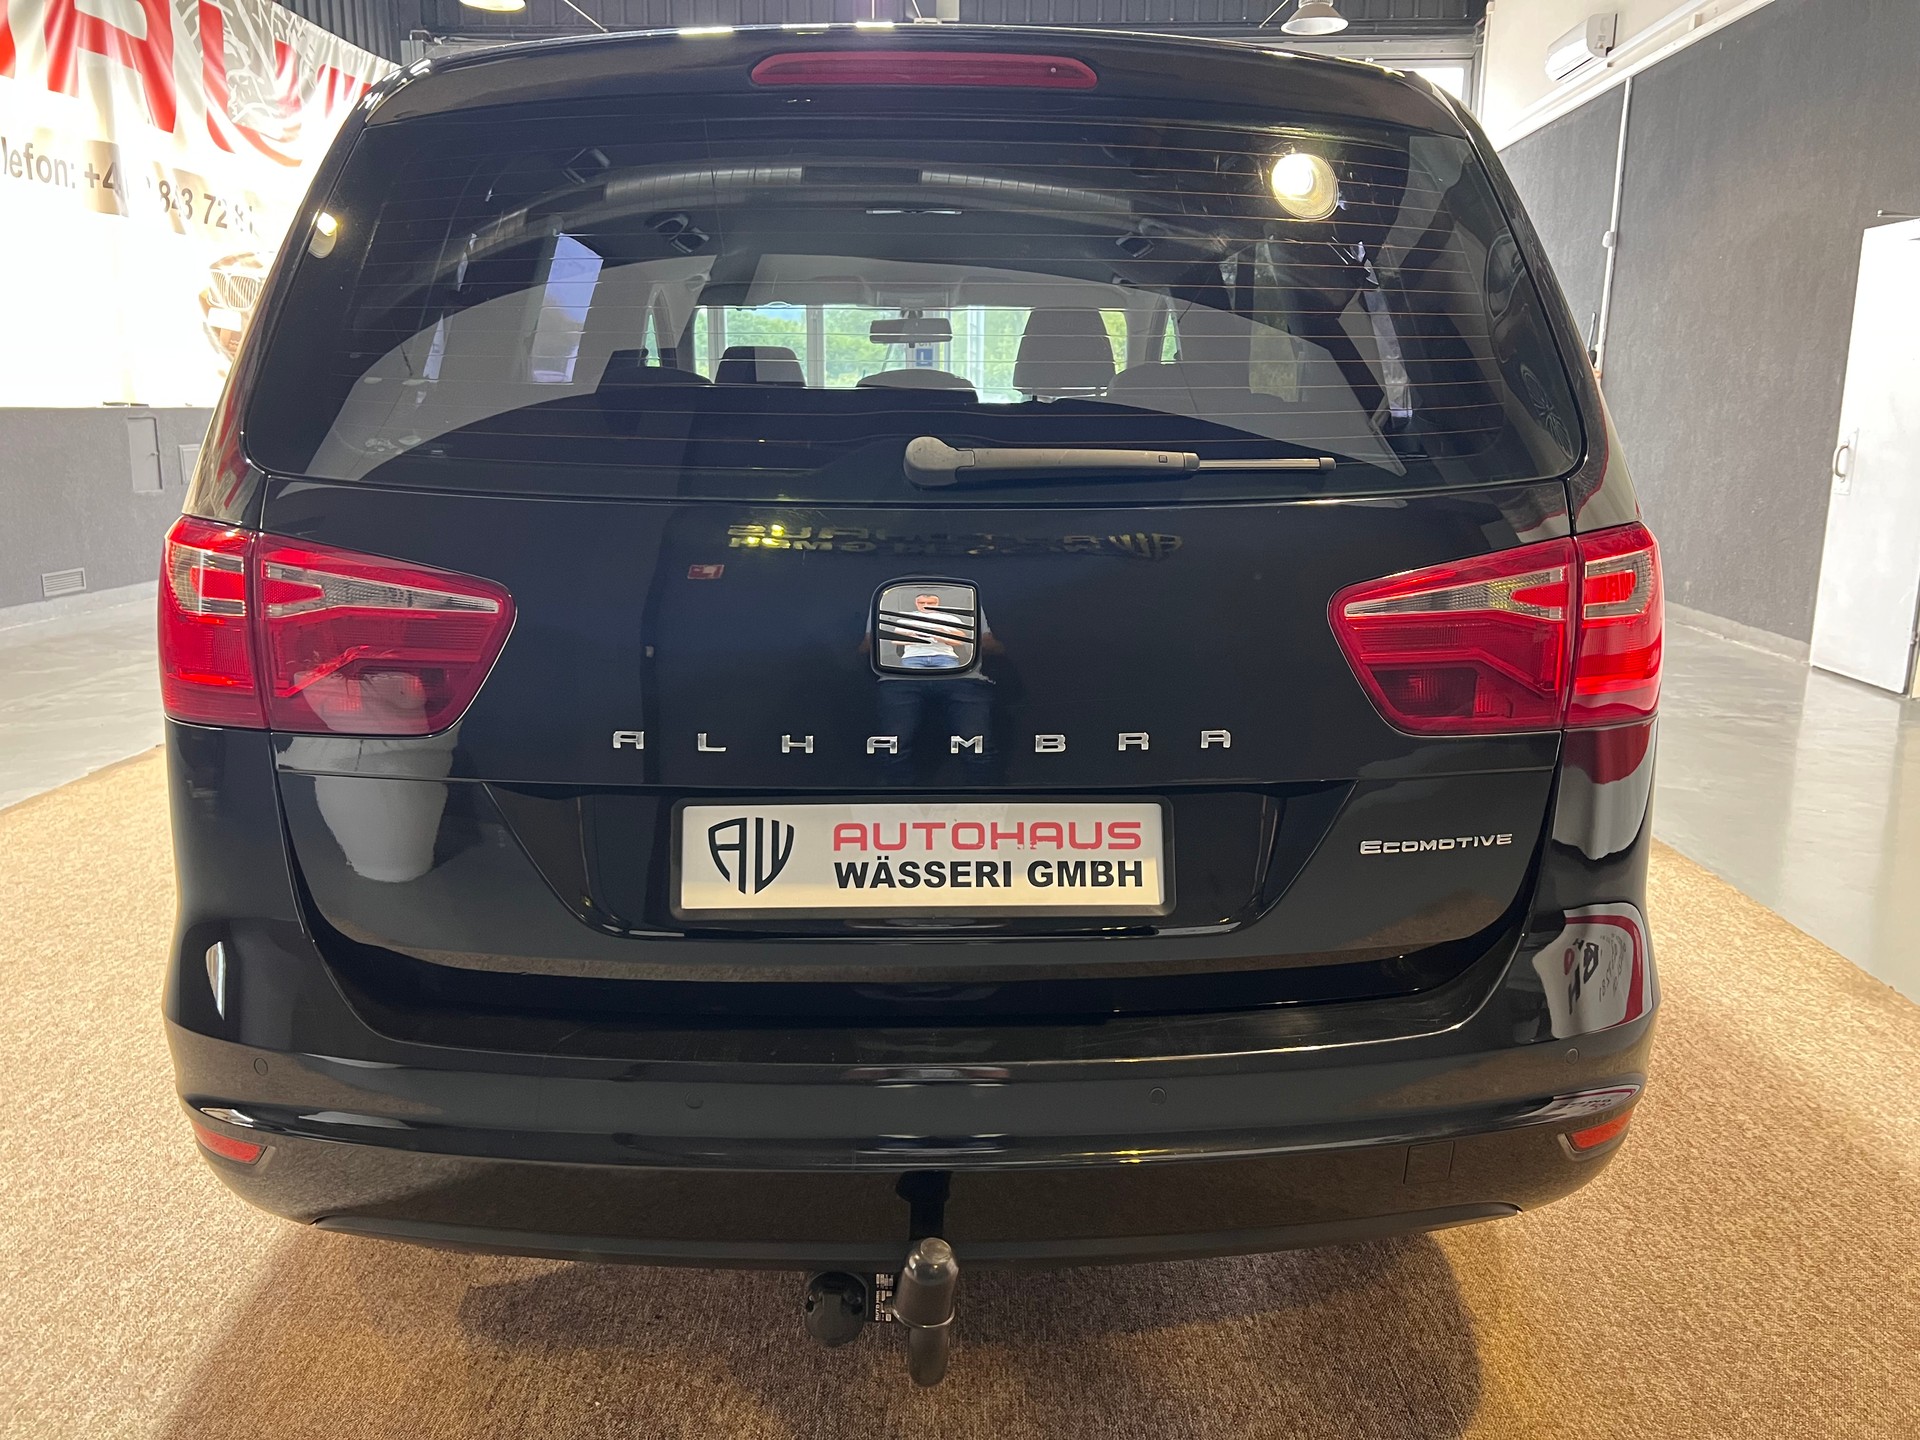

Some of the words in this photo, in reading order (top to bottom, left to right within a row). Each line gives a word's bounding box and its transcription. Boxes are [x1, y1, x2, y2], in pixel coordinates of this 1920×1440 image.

[612, 727, 1232, 754] ALHAMBRA
[832, 821, 1142, 851] AUTOHAUS
[833, 855, 1013, 890] WÄSSERI
[1026, 859, 1144, 888] GMBH
